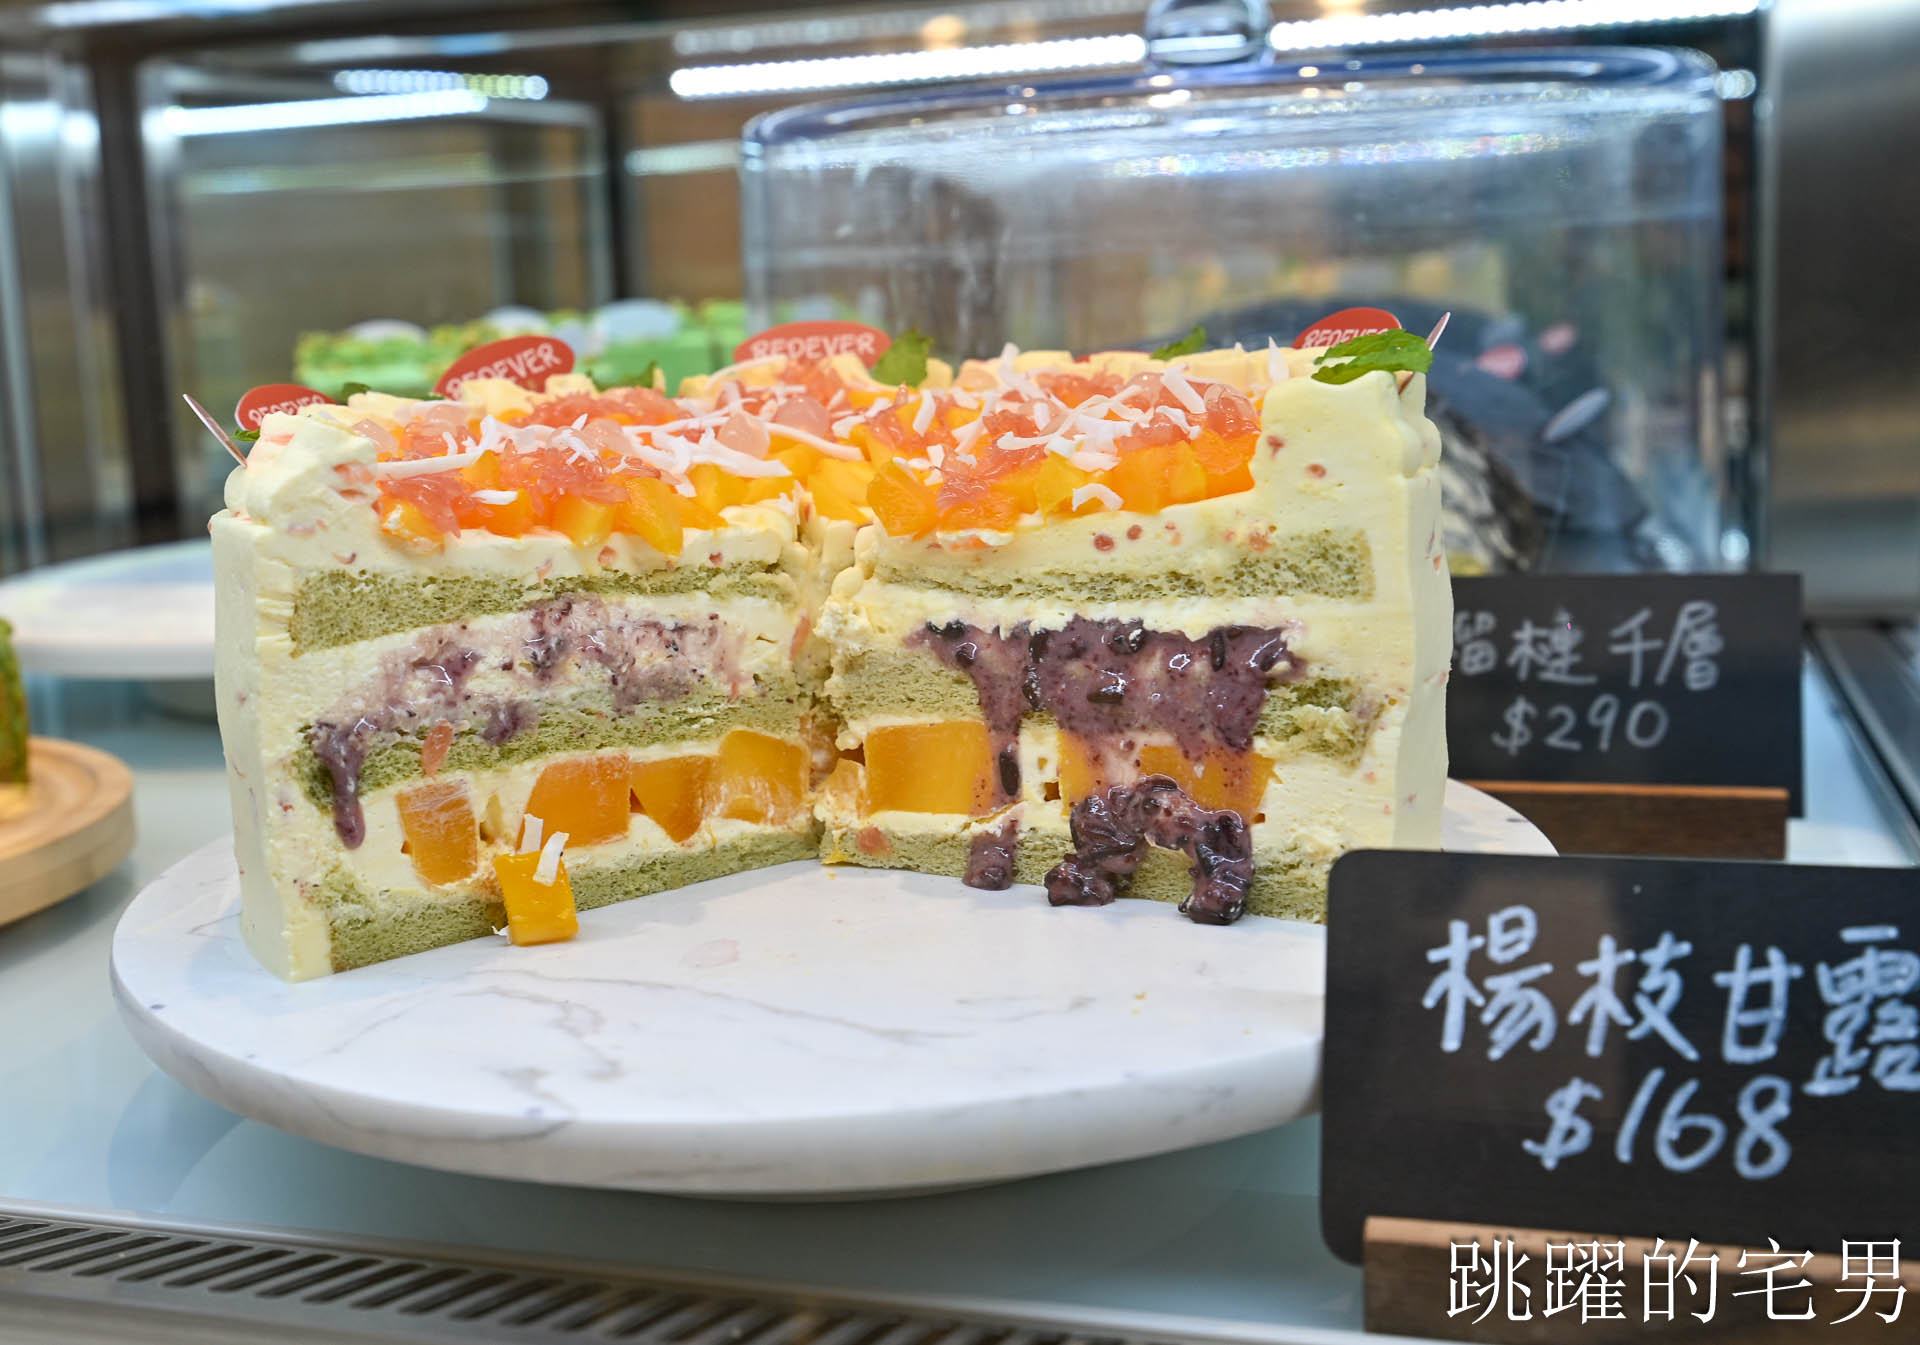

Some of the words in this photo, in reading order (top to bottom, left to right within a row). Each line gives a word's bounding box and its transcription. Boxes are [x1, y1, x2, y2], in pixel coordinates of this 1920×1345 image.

[1491, 693, 1670, 756] $290
[1421, 905, 1920, 1097] 楊枝甘露
[1522, 1068, 1793, 1181] $168
